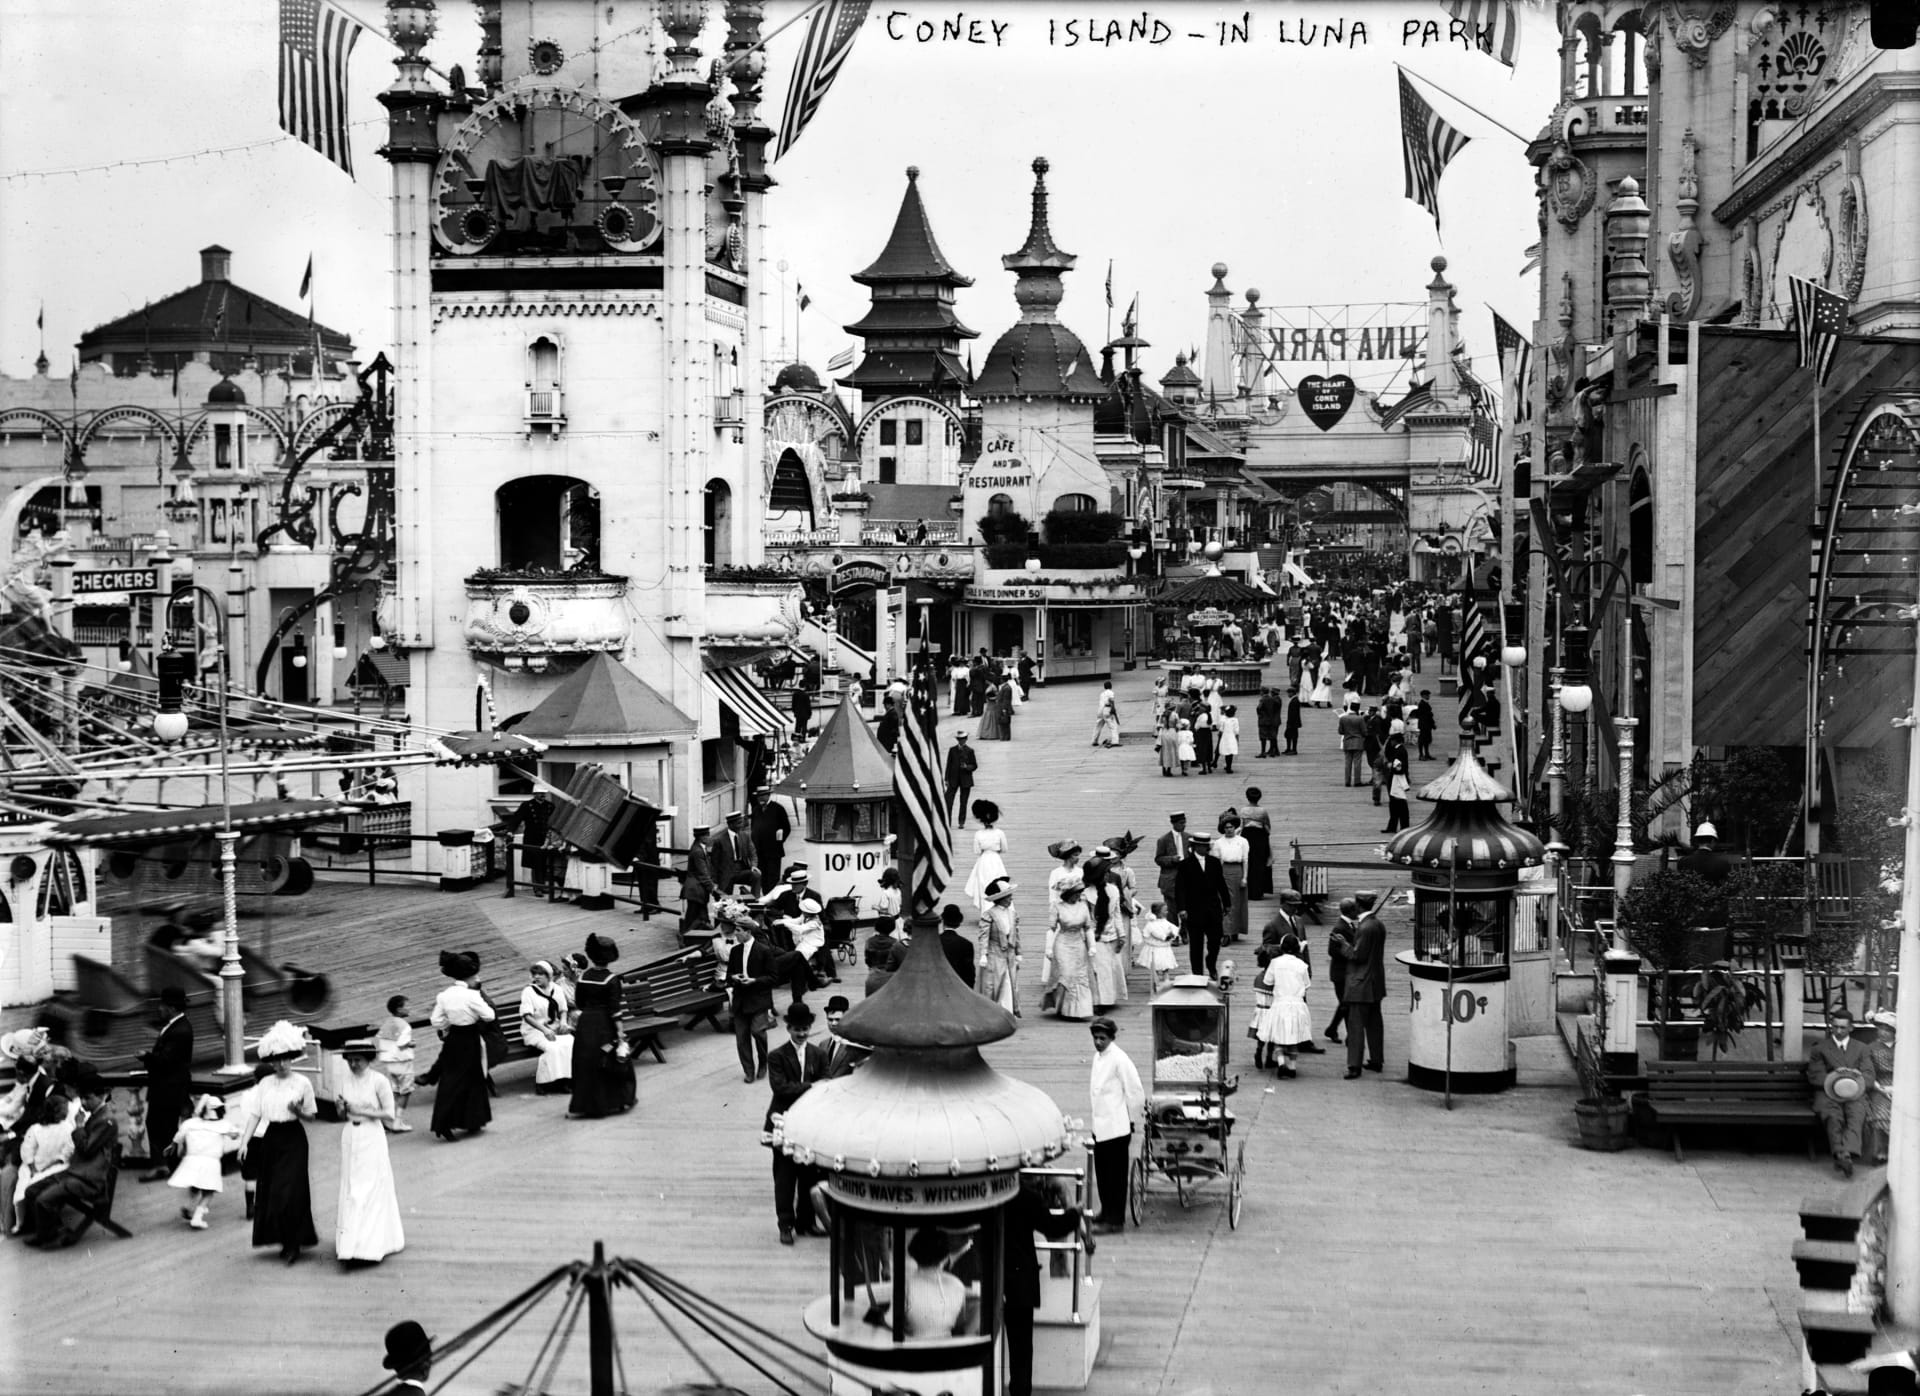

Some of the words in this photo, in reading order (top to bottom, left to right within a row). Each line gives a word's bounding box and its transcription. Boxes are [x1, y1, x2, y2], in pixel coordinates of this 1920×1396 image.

[987, 439, 1015, 453] CAFE
[992, 459, 1007, 468] AND
[968, 475, 1032, 488] RESTAURANT
[72, 572, 154, 590] CHECKERS
[836, 566, 887, 585] RESTAURANT
[997, 589, 1026, 598] DINNER
[924, 1181, 988, 1203] WITCHING
